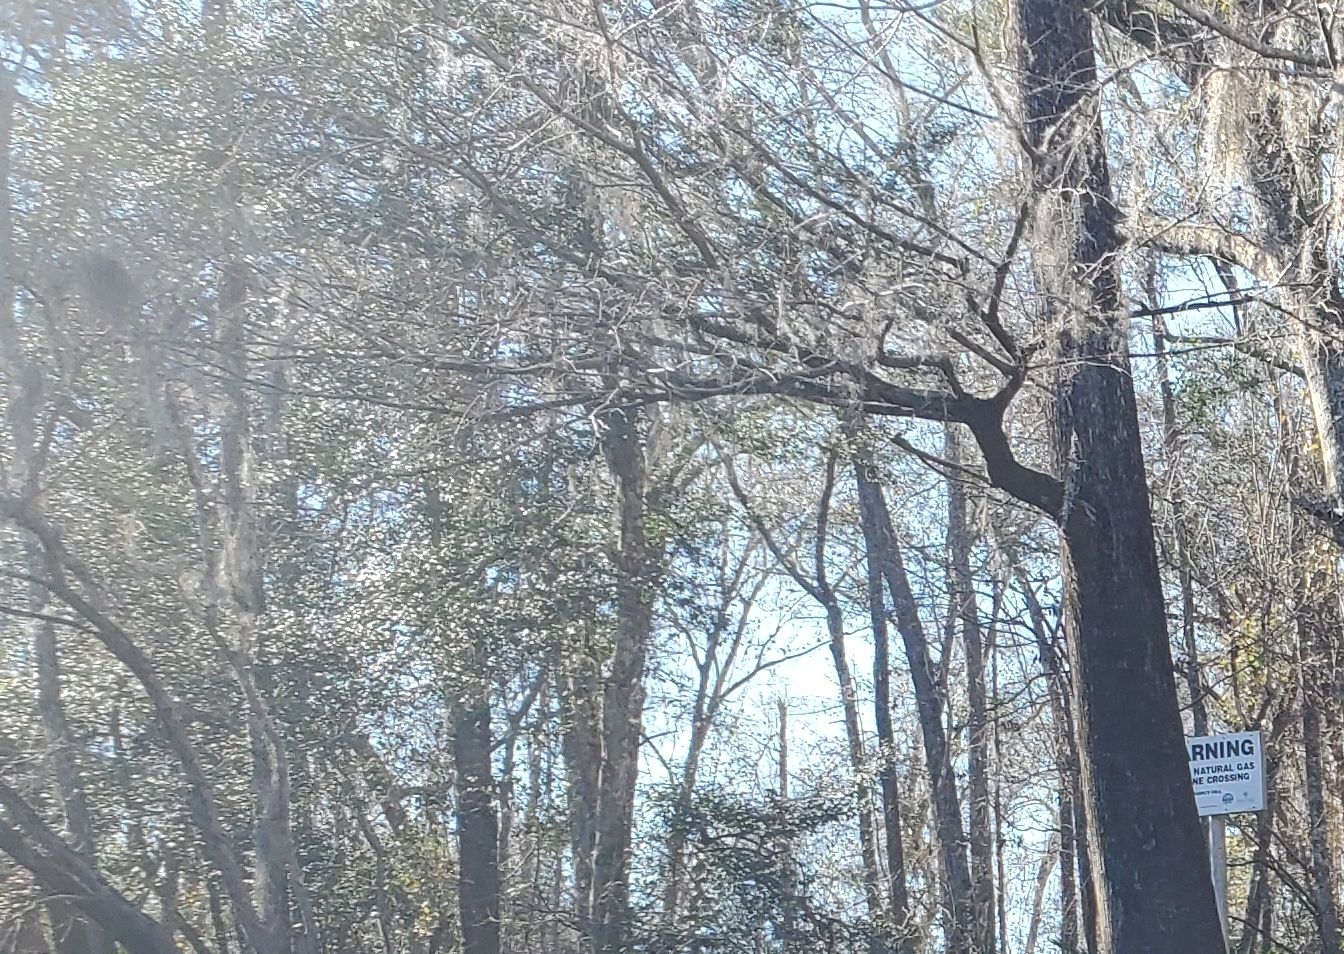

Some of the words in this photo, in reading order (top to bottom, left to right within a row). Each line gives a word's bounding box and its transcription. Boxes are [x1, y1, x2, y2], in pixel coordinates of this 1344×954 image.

[1190, 739, 1254, 761] RNING
[1193, 764, 1234, 775] NATURAL
[1236, 762, 1255, 771] GAS
[1207, 773, 1250, 784] CROSSING
